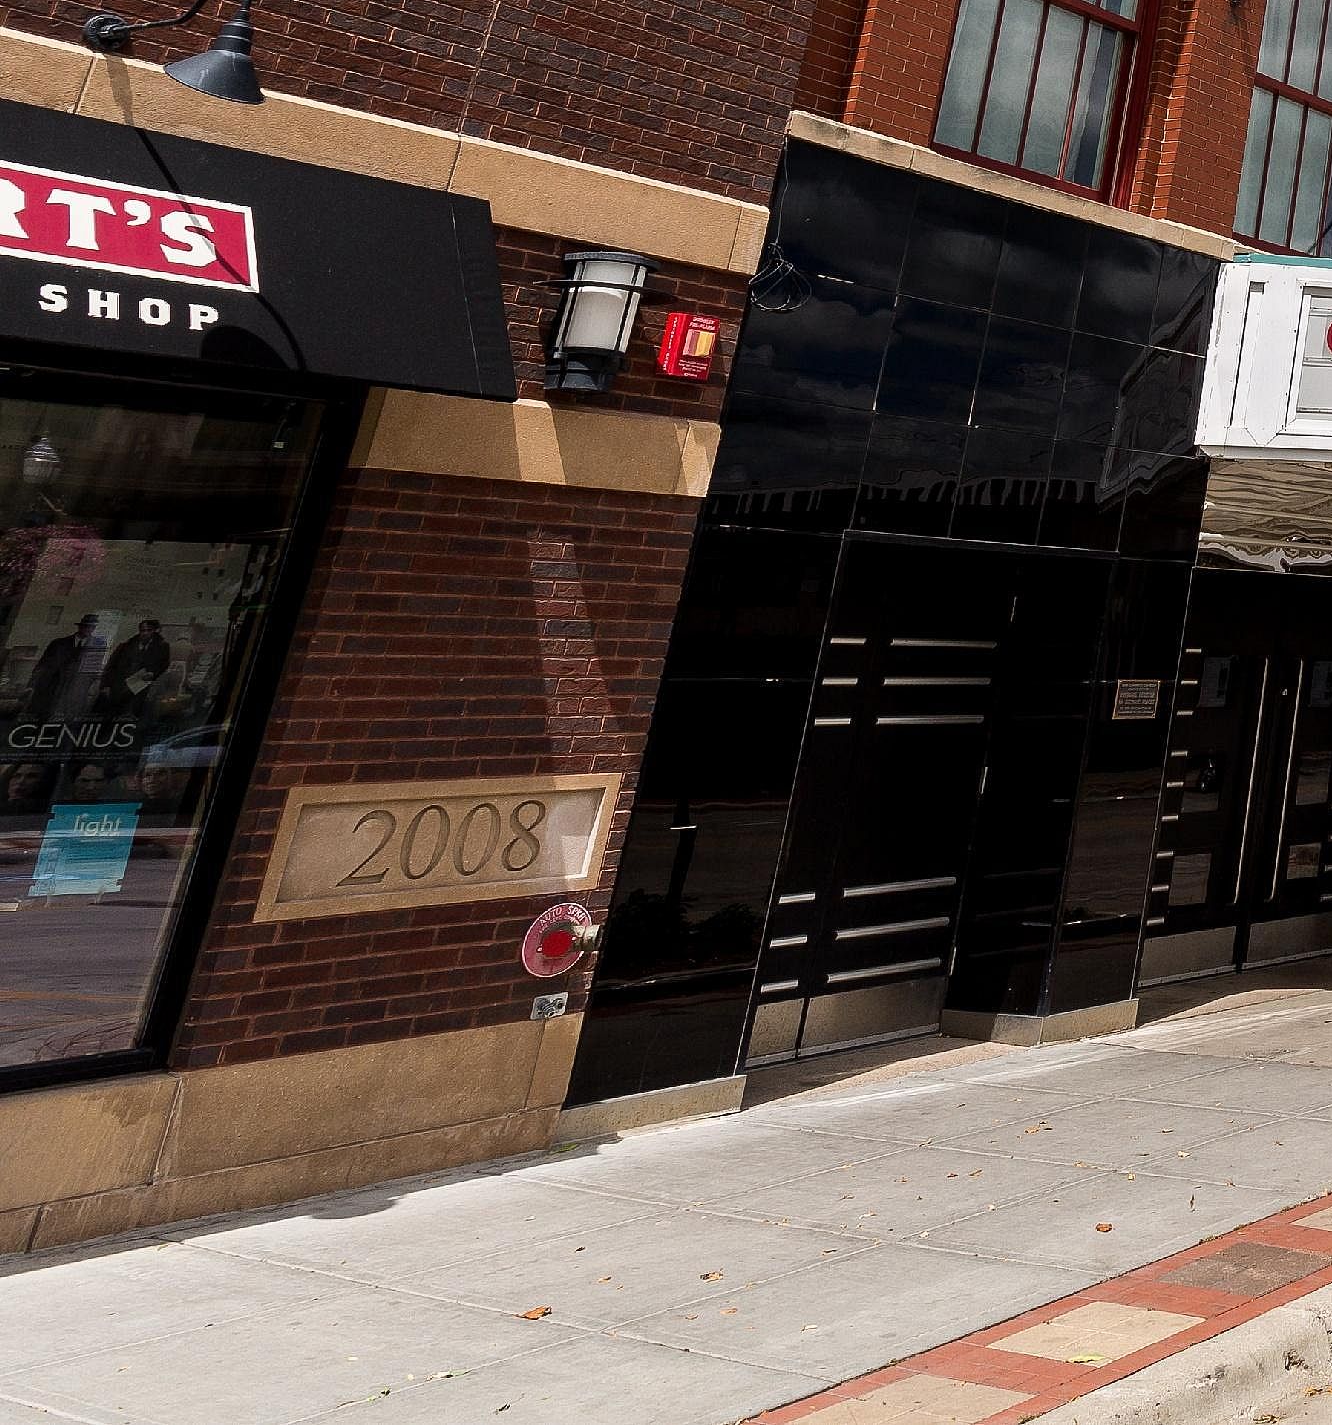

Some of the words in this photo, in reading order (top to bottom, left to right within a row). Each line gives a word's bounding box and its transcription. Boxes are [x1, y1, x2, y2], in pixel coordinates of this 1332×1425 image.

[38, 283, 219, 332] SHOP
[8, 723, 137, 748] GENIUS
[72, 813, 123, 835] light
[335, 799, 547, 887] 2008
[540, 907, 563, 927] AUTO
